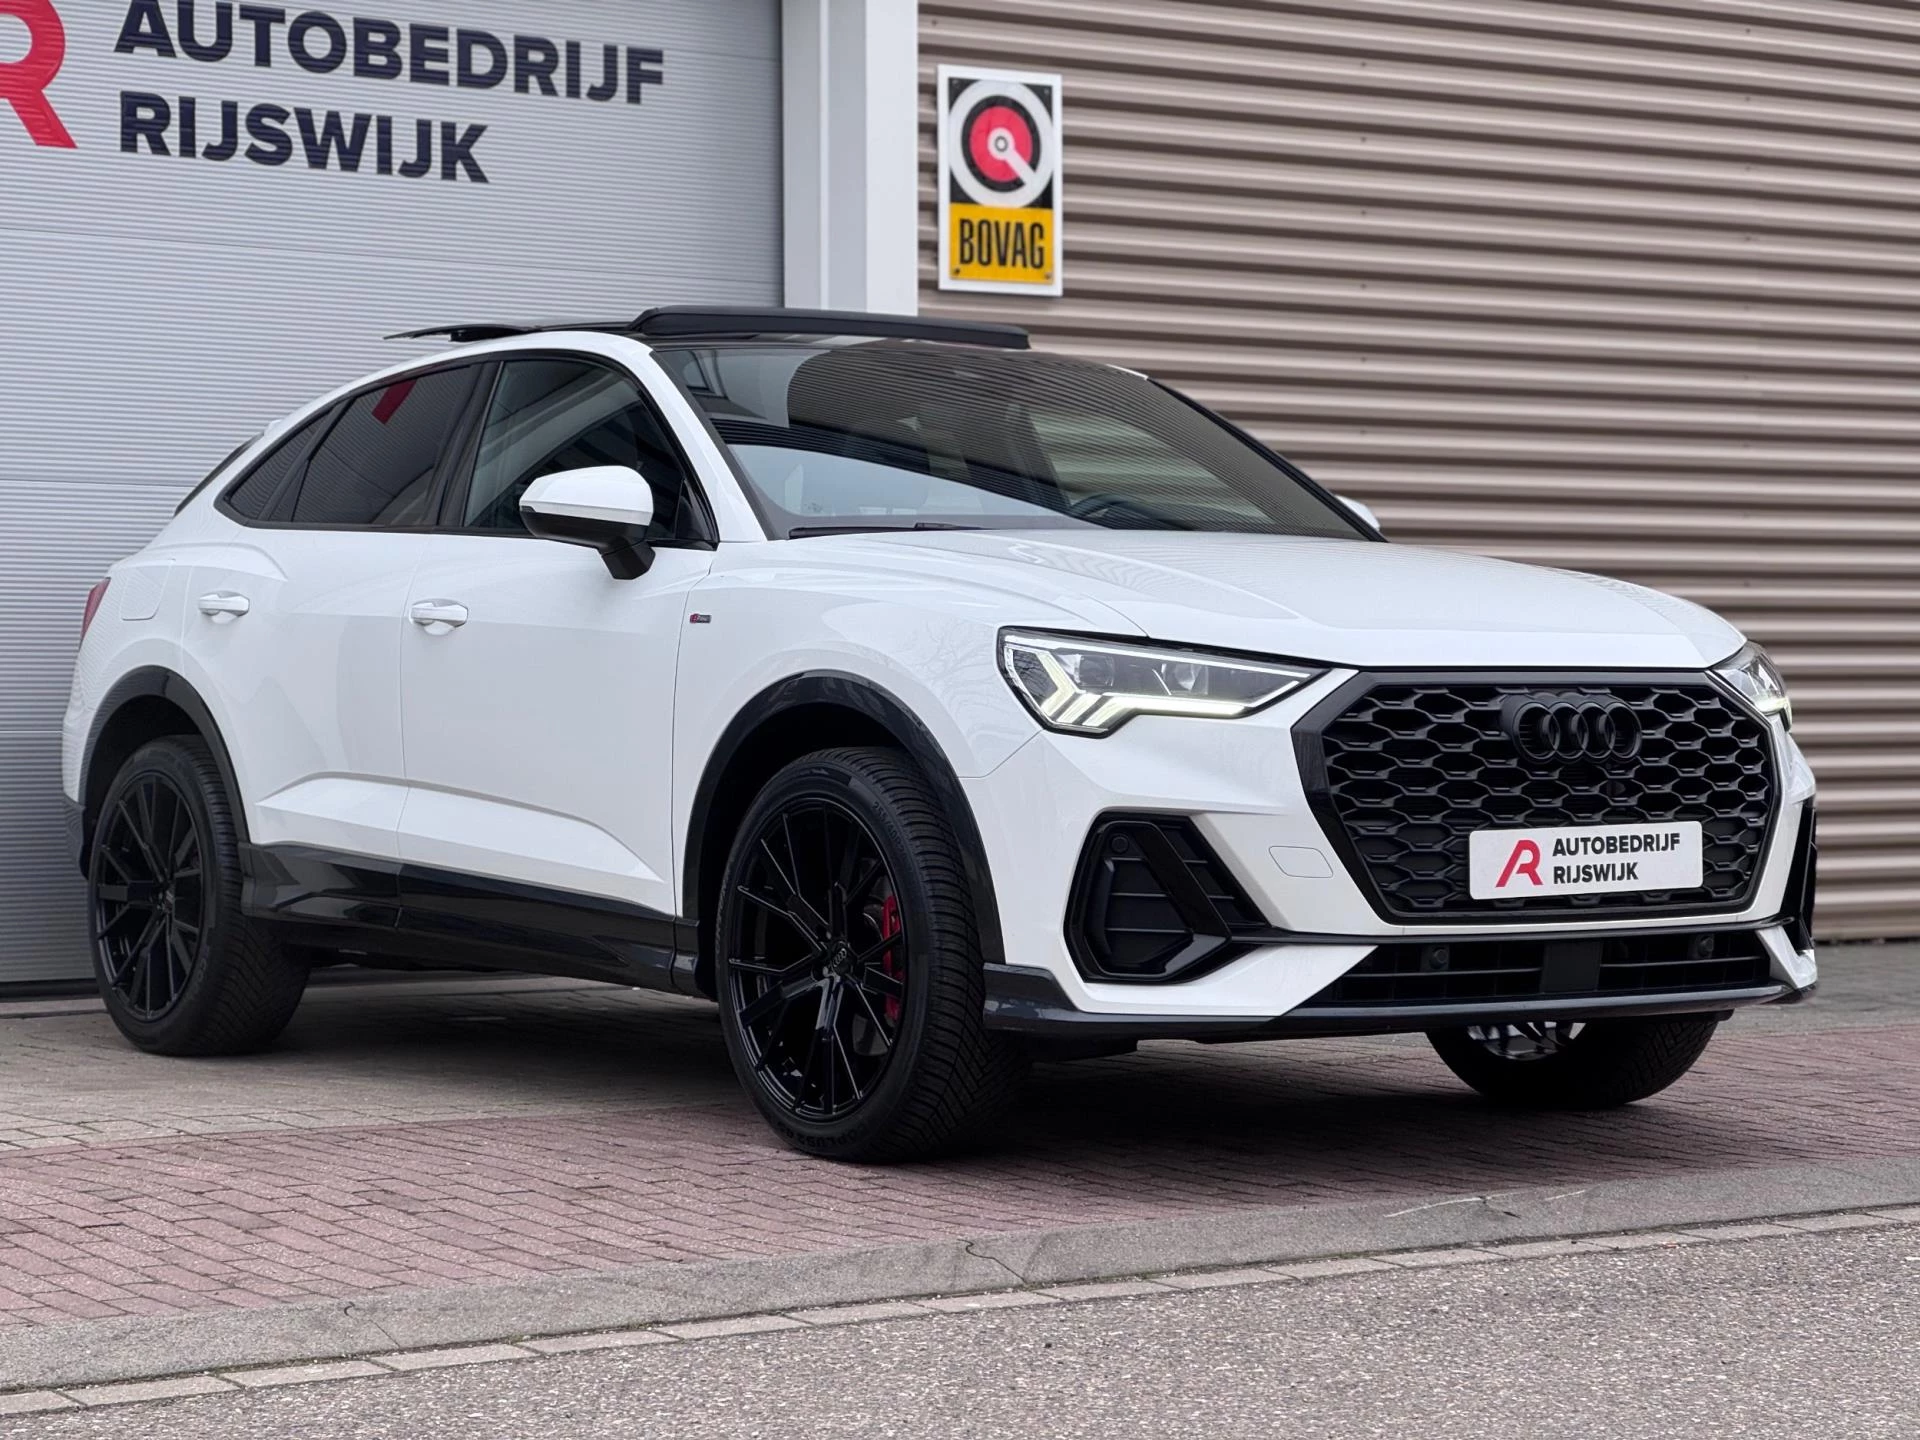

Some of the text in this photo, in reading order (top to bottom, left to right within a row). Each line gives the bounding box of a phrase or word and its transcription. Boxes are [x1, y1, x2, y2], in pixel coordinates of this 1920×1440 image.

[114, 0, 664, 104] AUTOBEDRIJF
[120, 90, 490, 183] RIJSWIJK
[959, 218, 1045, 270] BOVAG
[1552, 832, 1681, 857] AUTOBEDRIJF
[1553, 862, 1639, 885] RIJSWIJK
